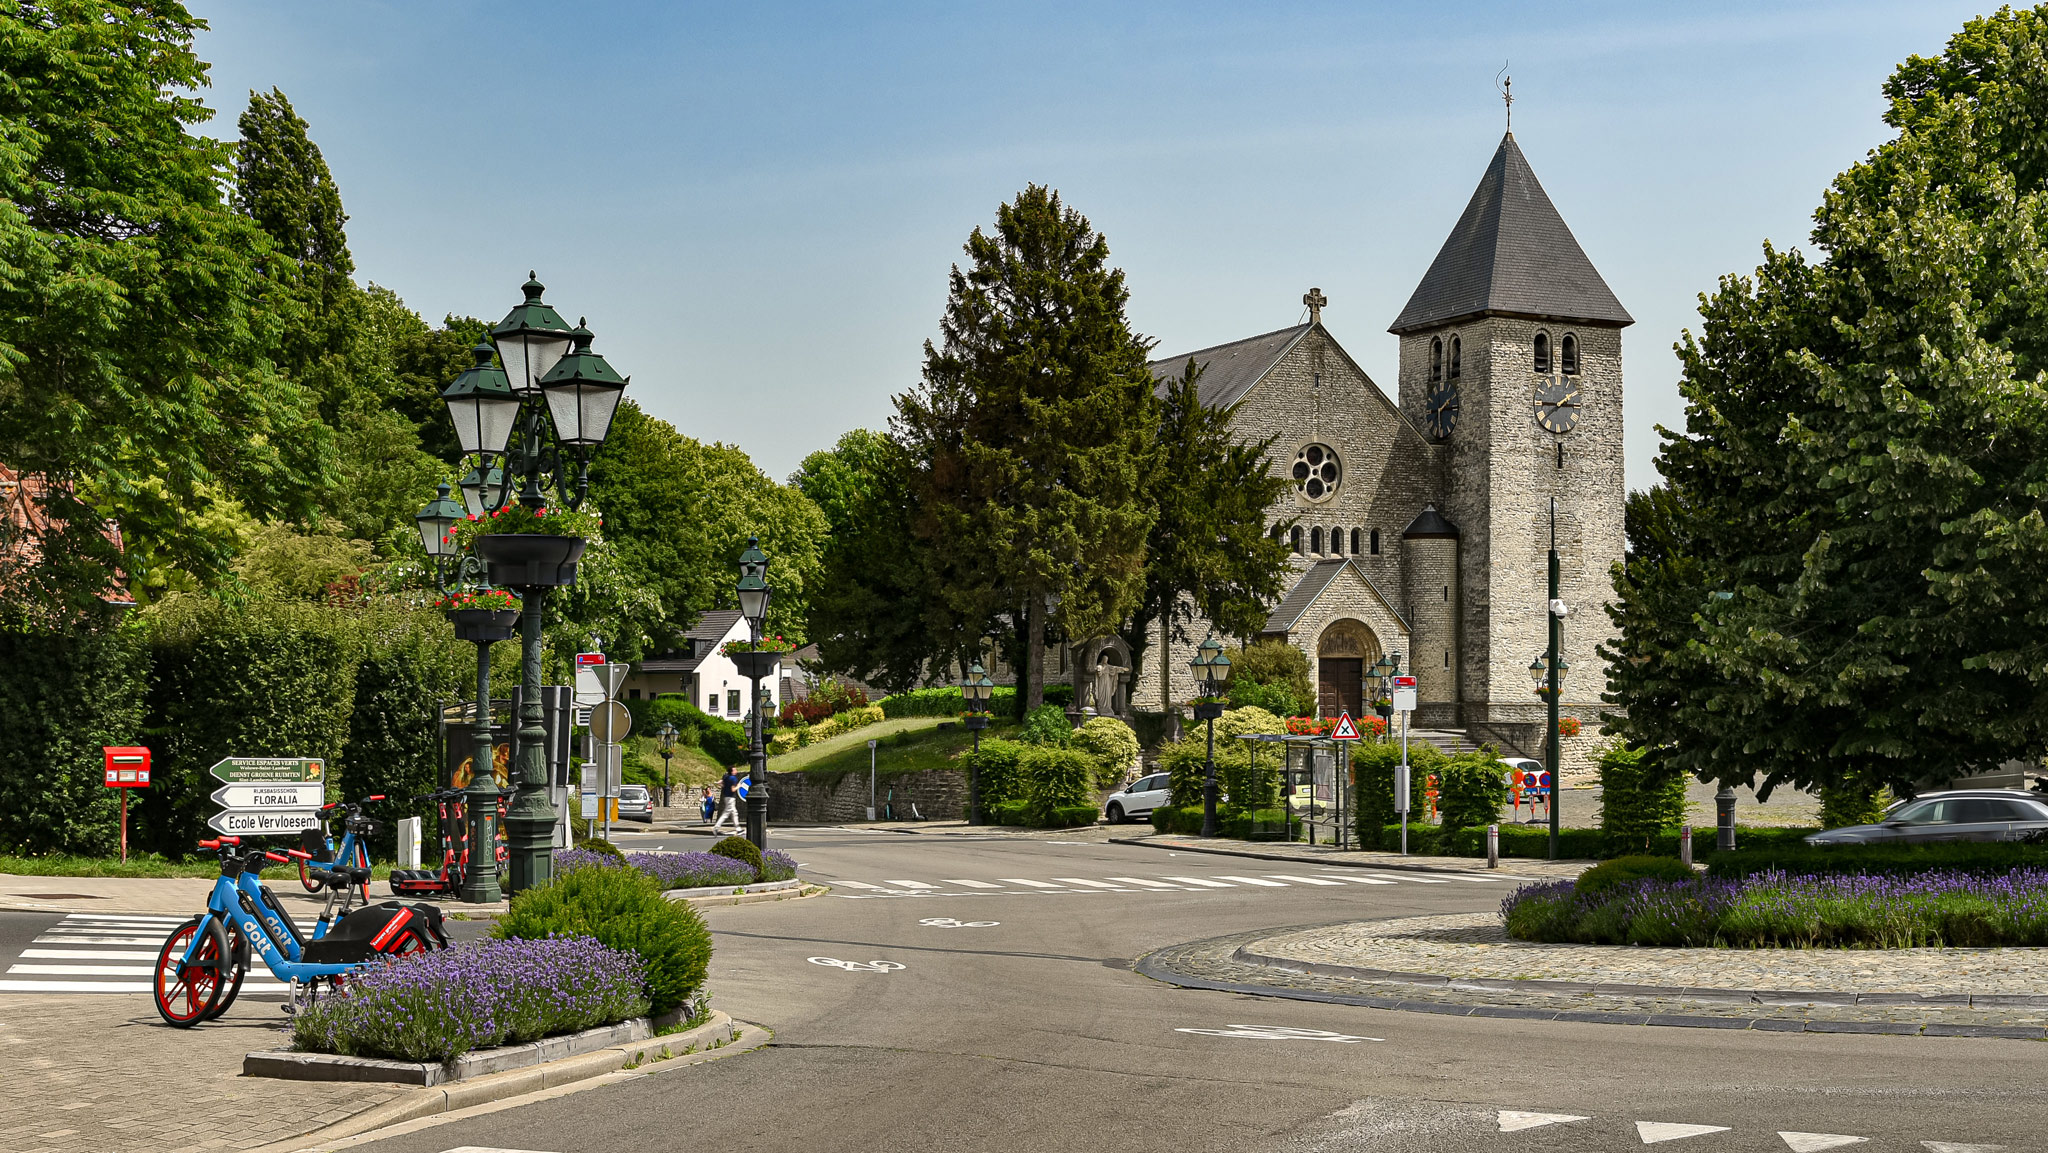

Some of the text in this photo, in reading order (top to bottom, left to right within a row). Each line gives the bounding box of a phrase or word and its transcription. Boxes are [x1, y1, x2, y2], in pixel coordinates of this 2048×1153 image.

[253, 795, 298, 805] FLORALIA
[229, 815, 316, 829] Ecole Vervloesem
[243, 921, 271, 956] dott
